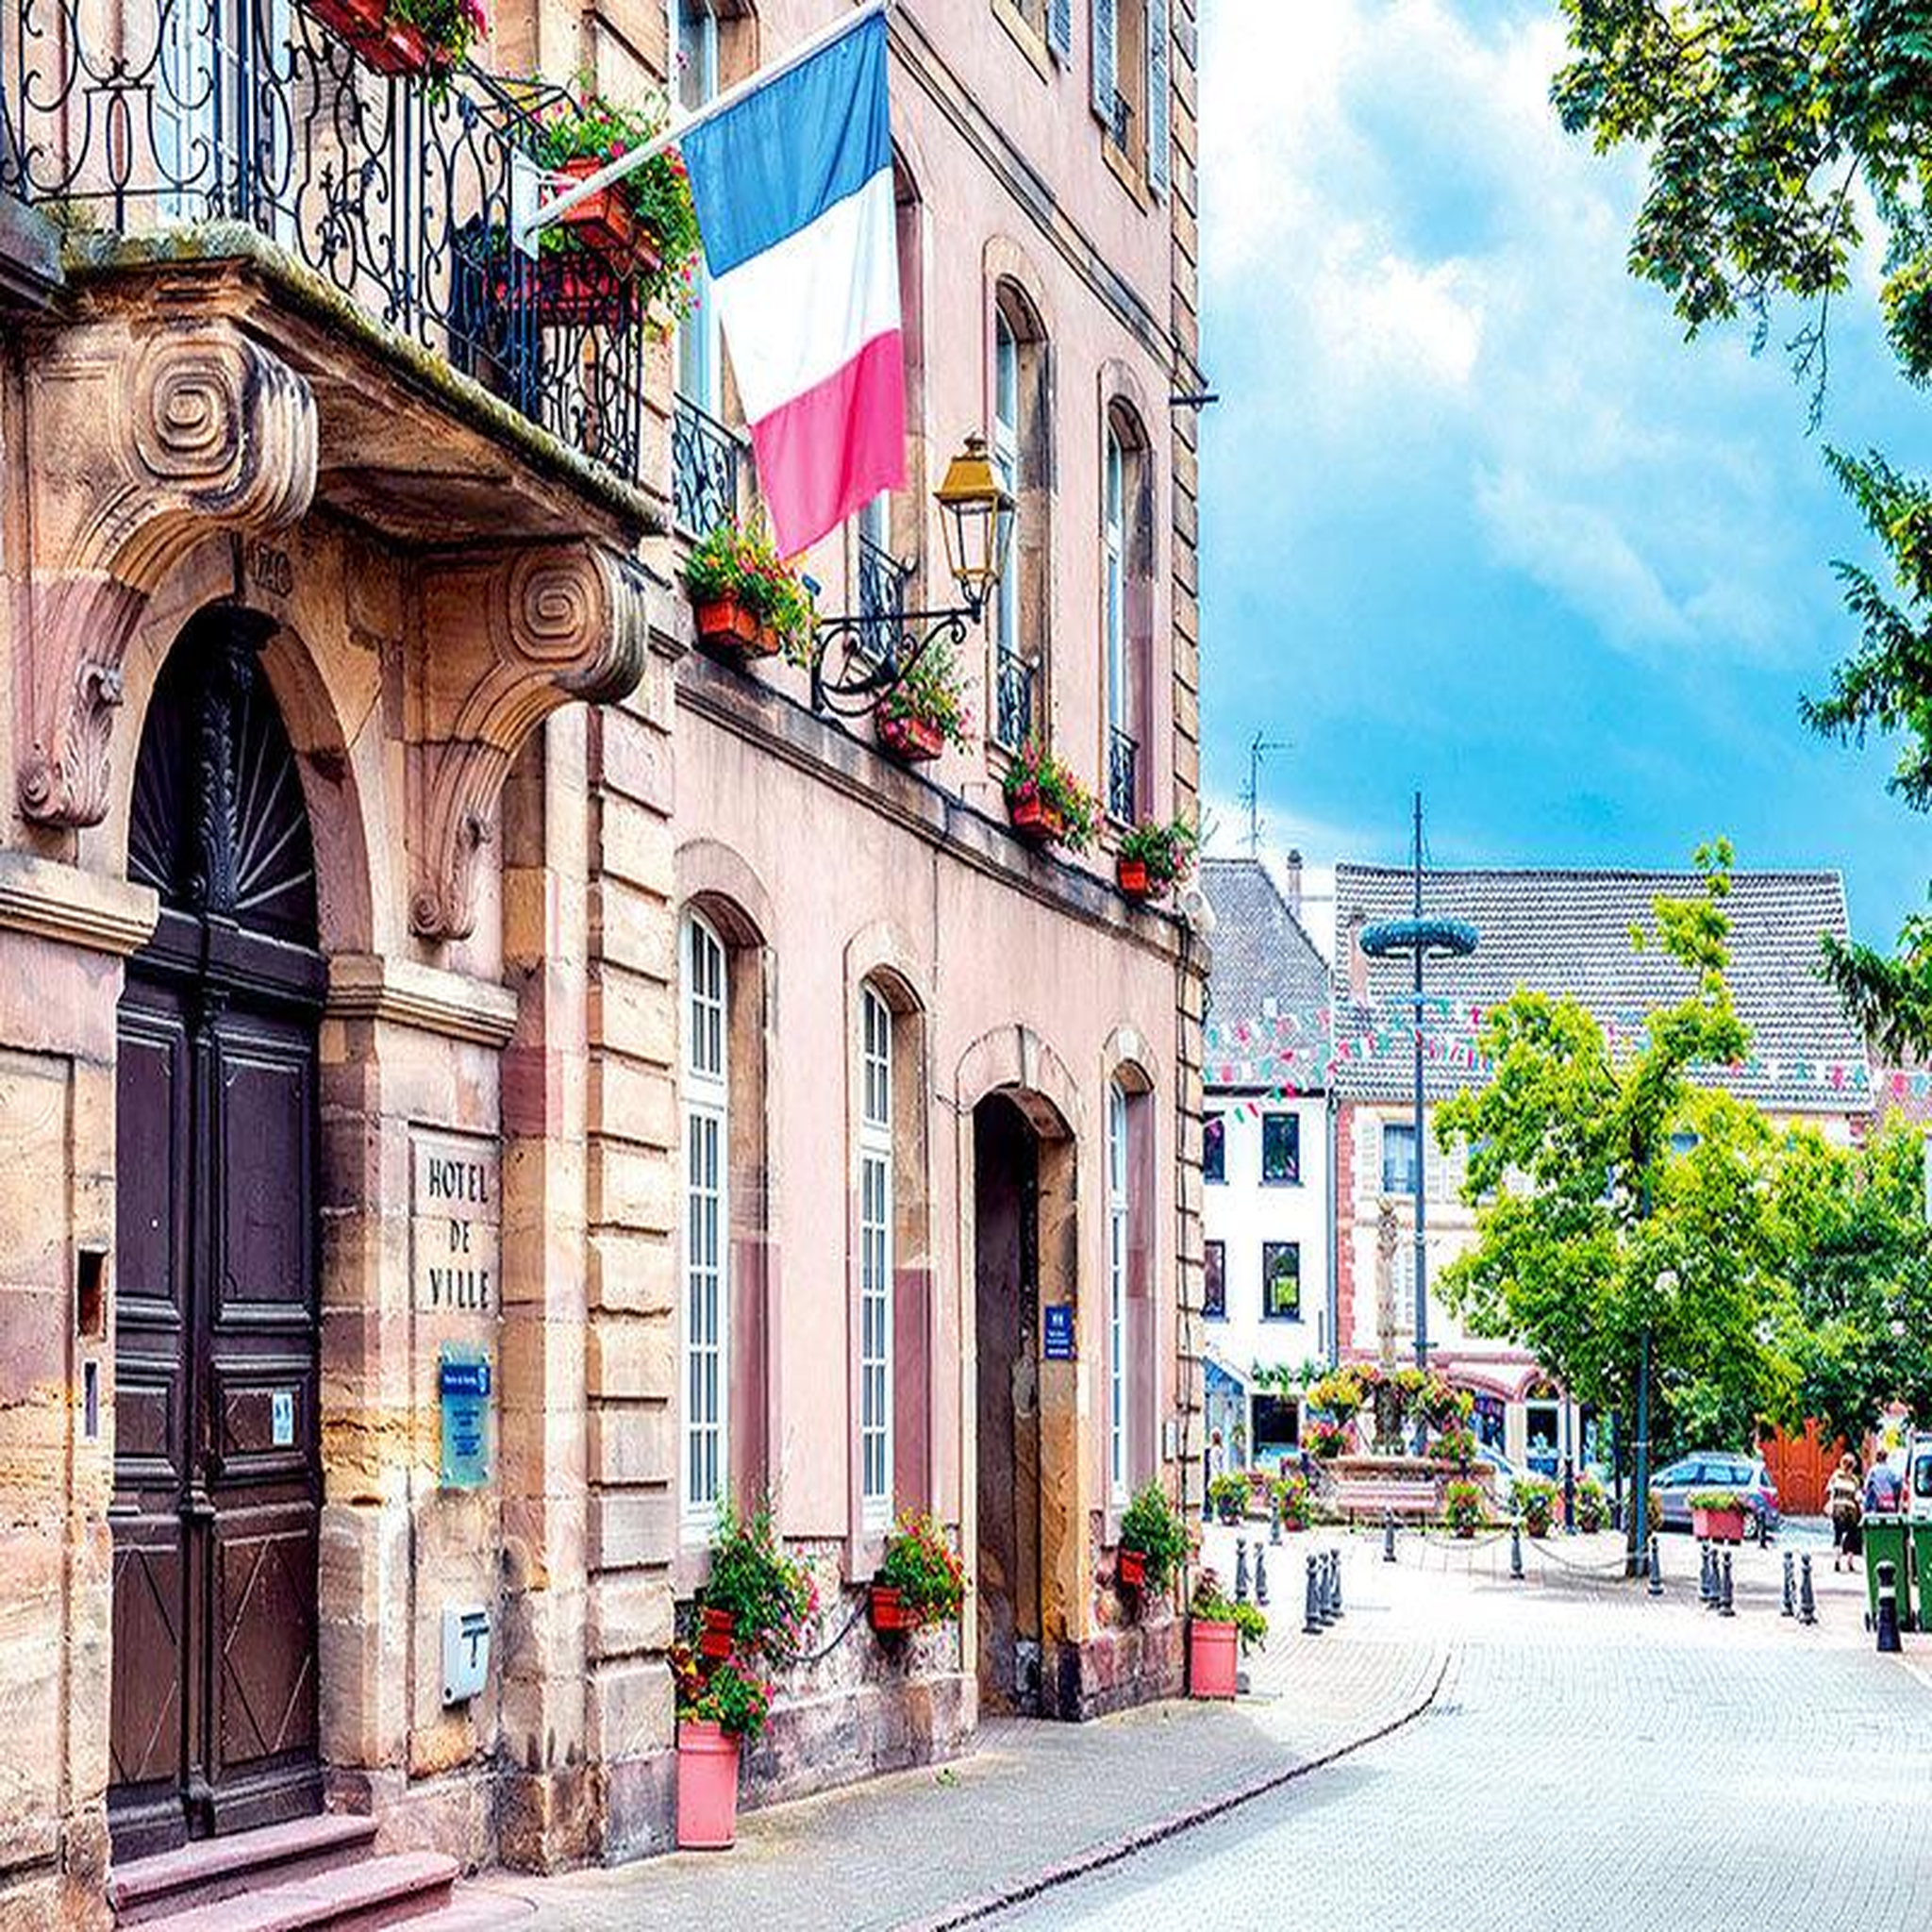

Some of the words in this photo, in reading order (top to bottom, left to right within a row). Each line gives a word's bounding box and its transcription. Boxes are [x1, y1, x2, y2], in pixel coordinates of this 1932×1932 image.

[428, 1158, 489, 1203] HOTEL
[449, 1218, 470, 1254] DE
[428, 1268, 489, 1309] VILLE
